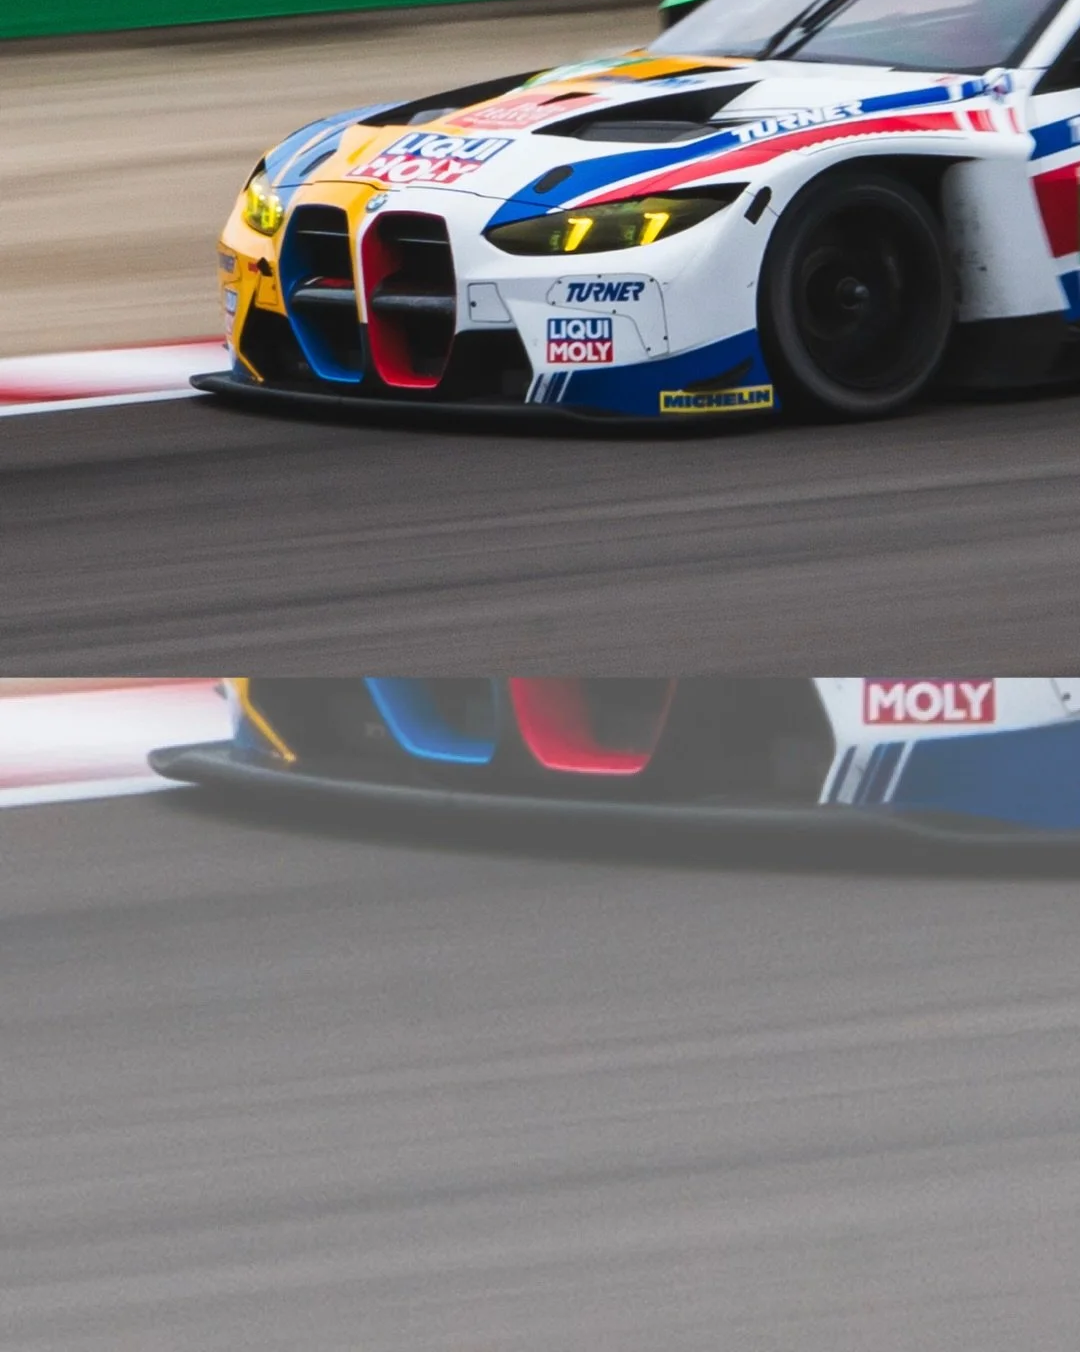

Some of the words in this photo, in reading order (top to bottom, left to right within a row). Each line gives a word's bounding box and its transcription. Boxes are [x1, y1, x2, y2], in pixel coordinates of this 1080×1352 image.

[729, 99, 863, 144] TURNER
[385, 132, 508, 161] LIQUI
[350, 154, 482, 183] MOLY
[565, 281, 646, 303] TURNER
[550, 319, 610, 341] LIQUI
[549, 341, 613, 362] MOLY
[664, 390, 770, 409] MICHELIN
[867, 681, 995, 722] MOLY
